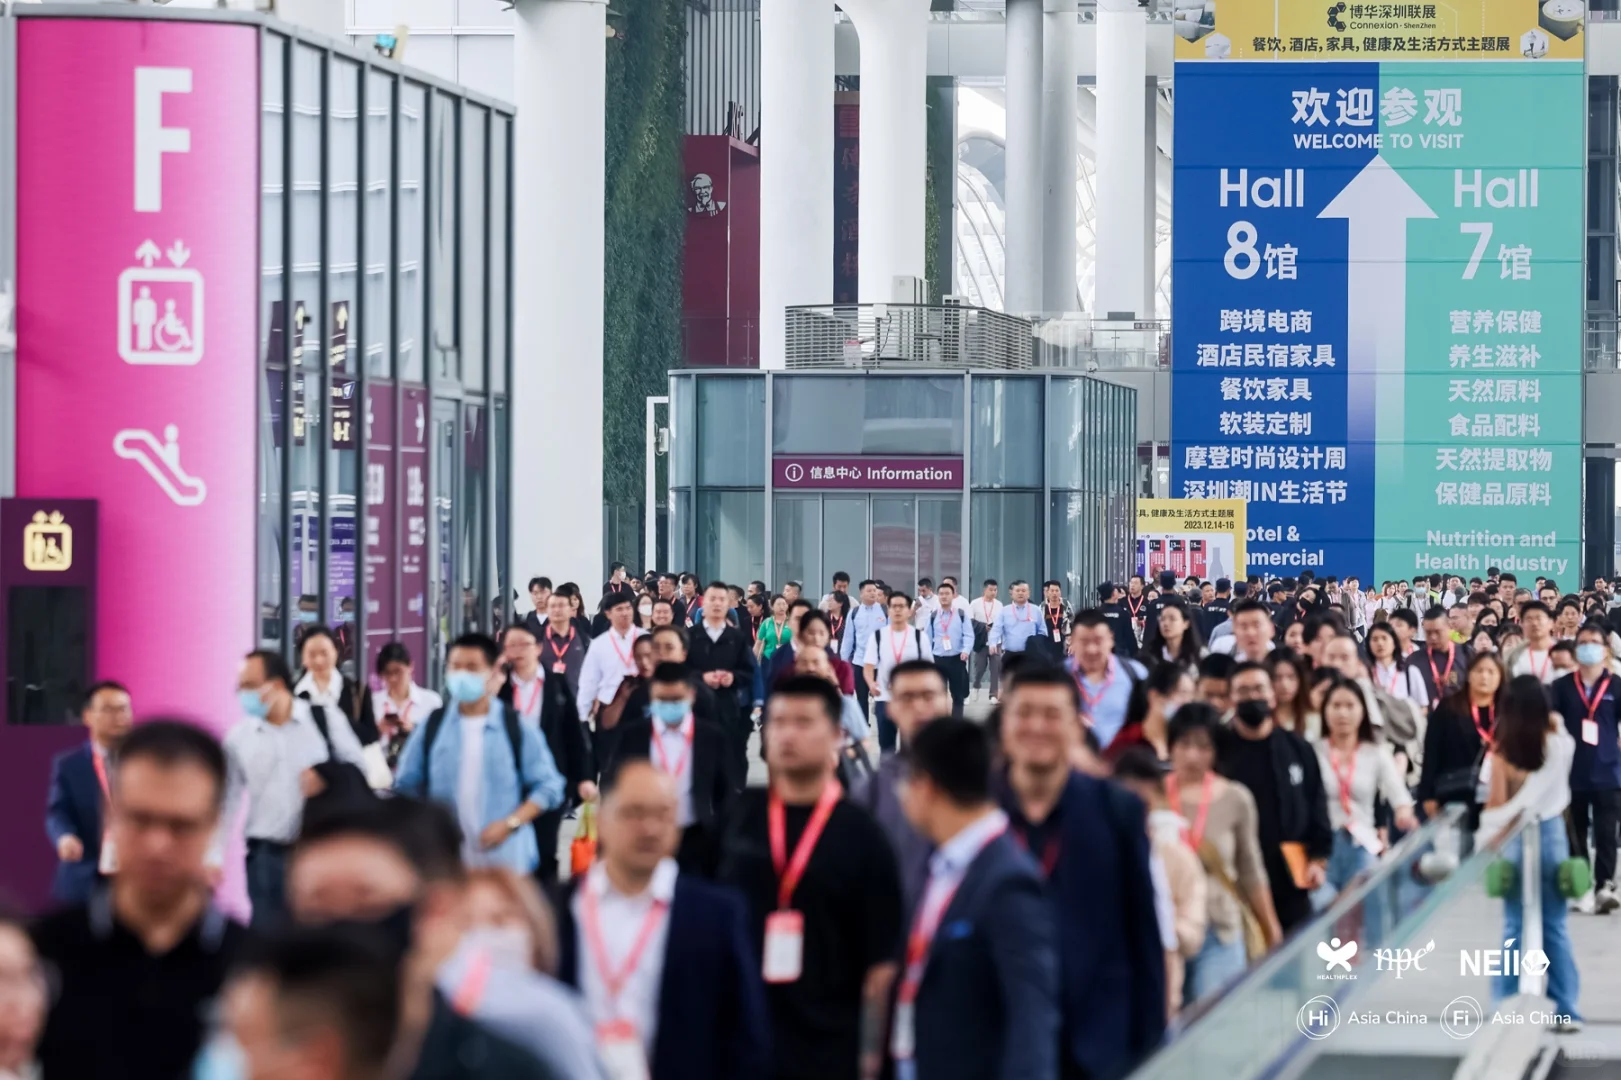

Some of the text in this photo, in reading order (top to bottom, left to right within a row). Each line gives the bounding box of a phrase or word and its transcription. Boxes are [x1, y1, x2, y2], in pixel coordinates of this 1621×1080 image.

[1350, 4, 1436, 19] 博华深圳联展
[1350, 21, 1399, 30] Connexion
[1291, 86, 1463, 127] 欢迎参观
[134, 67, 192, 212] F
[1293, 134, 1464, 149] WELCOME TO VISIT
[1219, 168, 1304, 208] Hall
[1454, 168, 1539, 208] Hall
[1223, 220, 1299, 280] 8馆
[1460, 222, 1533, 280] 7馆
[1219, 309, 1312, 333] 跨境电商
[1449, 310, 1542, 334] 营养保健
[1196, 343, 1336, 368] 酒店民宿家具
[1448, 344, 1542, 369] 养生滋补
[1220, 377, 1312, 402] 餐饮家具
[1448, 379, 1542, 403] 天然原料
[1219, 411, 1312, 436] 软装定制
[1448, 413, 1541, 437] 食品配料
[1184, 446, 1346, 470] 摩登时尚设计周
[1435, 448, 1553, 471] 天然提取物
[810, 466, 953, 480] 信息中心 Information
[1183, 479, 1348, 504] 深圳潮IN生活节
[1434, 482, 1552, 506] 保健品原料
[1184, 520, 1235, 530] 2023.12.14-16
[1246, 525, 1301, 542] otel &
[1426, 530, 1556, 548] Nutrition and
[1246, 548, 1324, 566] mercial
[1415, 552, 1568, 574] Health Industry
